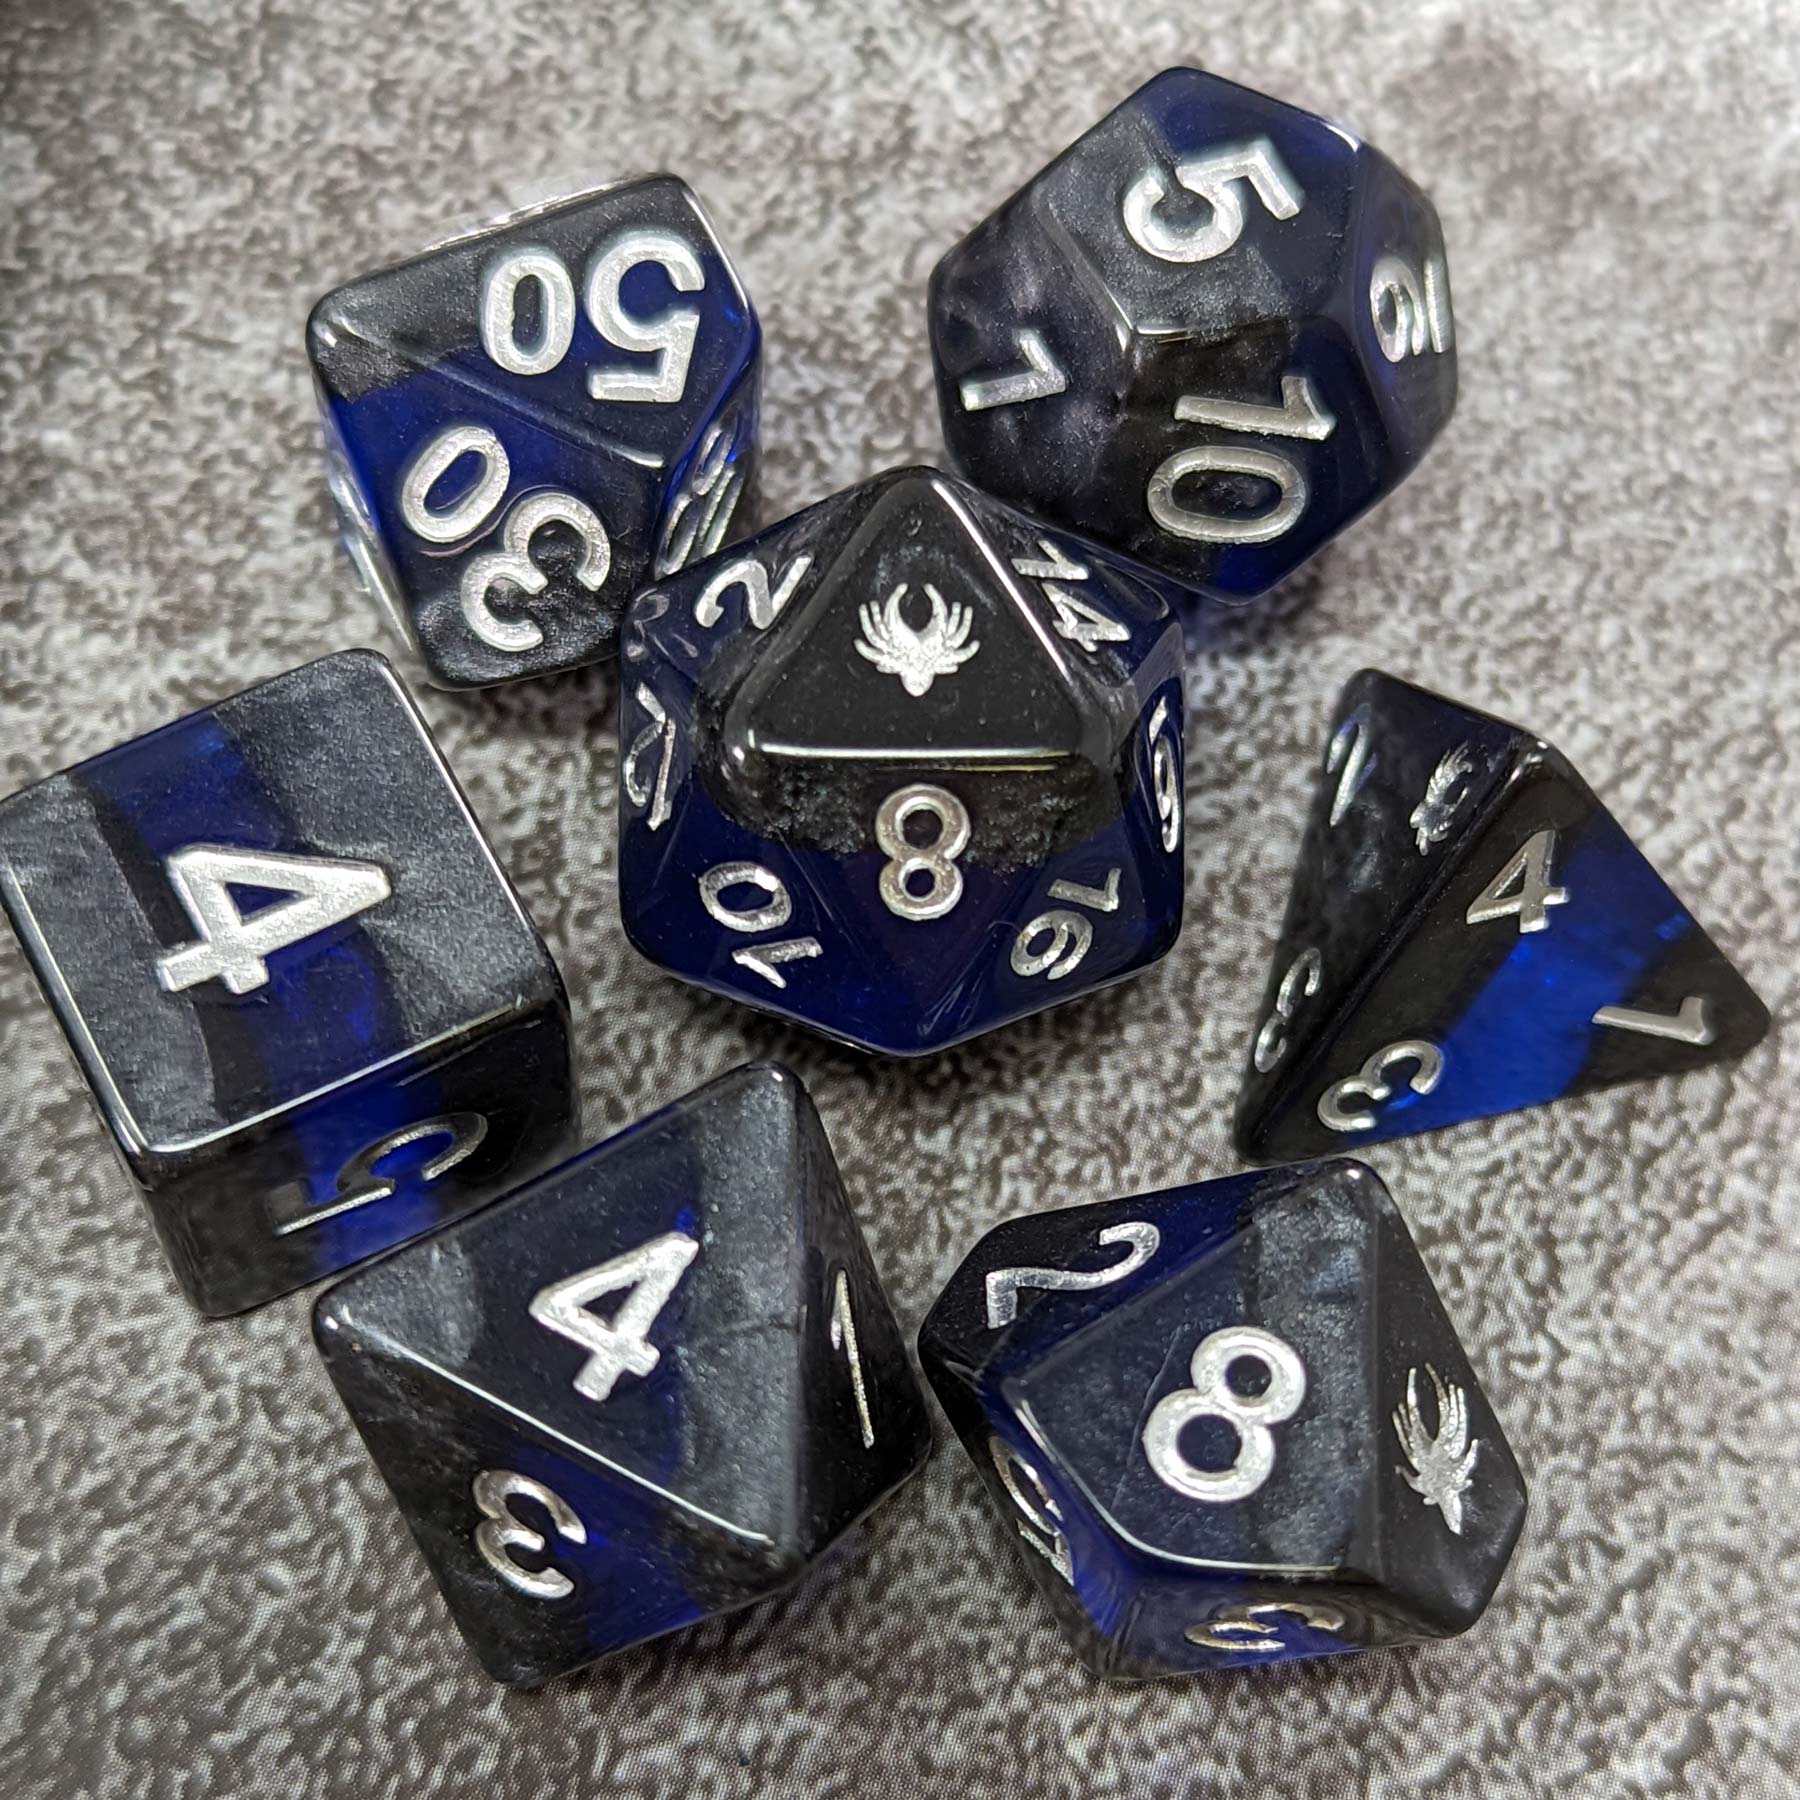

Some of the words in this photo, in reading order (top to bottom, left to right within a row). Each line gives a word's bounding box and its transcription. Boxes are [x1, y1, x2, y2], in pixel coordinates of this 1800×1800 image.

[1123, 137, 1301, 264] 5
[480, 228, 706, 404] 50
[1146, 374, 1338, 545] 10
[402, 426, 611, 653] 30
[694, 553, 814, 630] 2
[1011, 539, 1132, 653] 14
[874, 783, 973, 921] 8
[1464, 829, 1569, 934] 4
[158, 845, 393, 995] 4
[698, 861, 824, 989] 10
[1008, 867, 1122, 981] 16
[1254, 947, 1322, 1074] 3
[1591, 996, 1717, 1046] 1
[1316, 1040, 1445, 1132] 3
[262, 1111, 488, 1236] 5
[528, 1231, 700, 1402] 4
[985, 1221, 1161, 1330] 2
[1142, 1325, 1307, 1503] 8
[471, 1469, 588, 1600] 3
